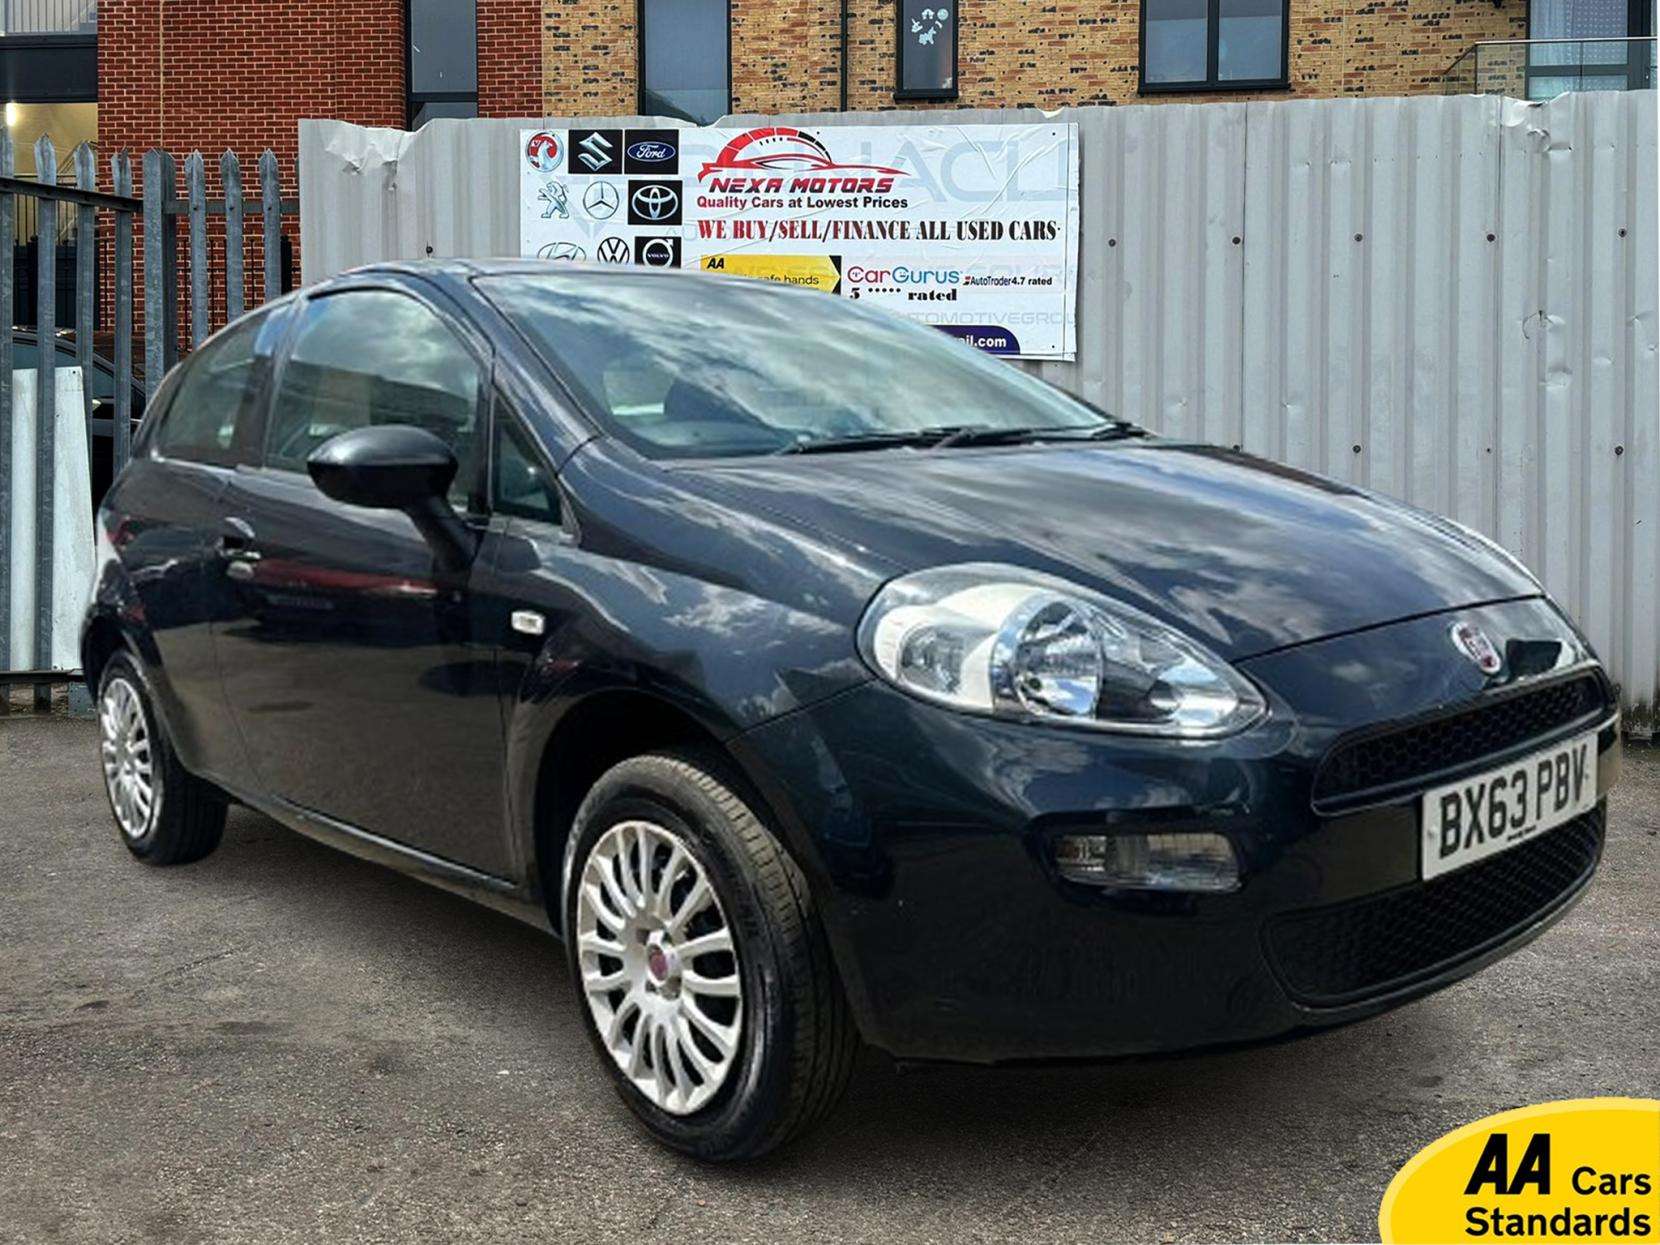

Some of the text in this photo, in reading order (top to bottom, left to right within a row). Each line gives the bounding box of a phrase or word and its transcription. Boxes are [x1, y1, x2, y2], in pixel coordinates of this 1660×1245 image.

[637, 144, 666, 158] Ford
[709, 177, 894, 193] NEXA MOTORS
[697, 196, 908, 210] Quality Cars at Lowest Prices
[697, 220, 726, 239] WE
[916, 220, 951, 240] ALL
[957, 220, 1003, 240] USED
[1009, 220, 1057, 240] CARS
[707, 257, 725, 269] AA
[784, 275, 819, 285] hands
[847, 266, 960, 283] CarGurus
[970, 276, 1053, 286] AutoTrader 4.7 rated
[850, 287, 957, 301] 5 rated
[1440, 744, 1587, 859] BX63 PBV
